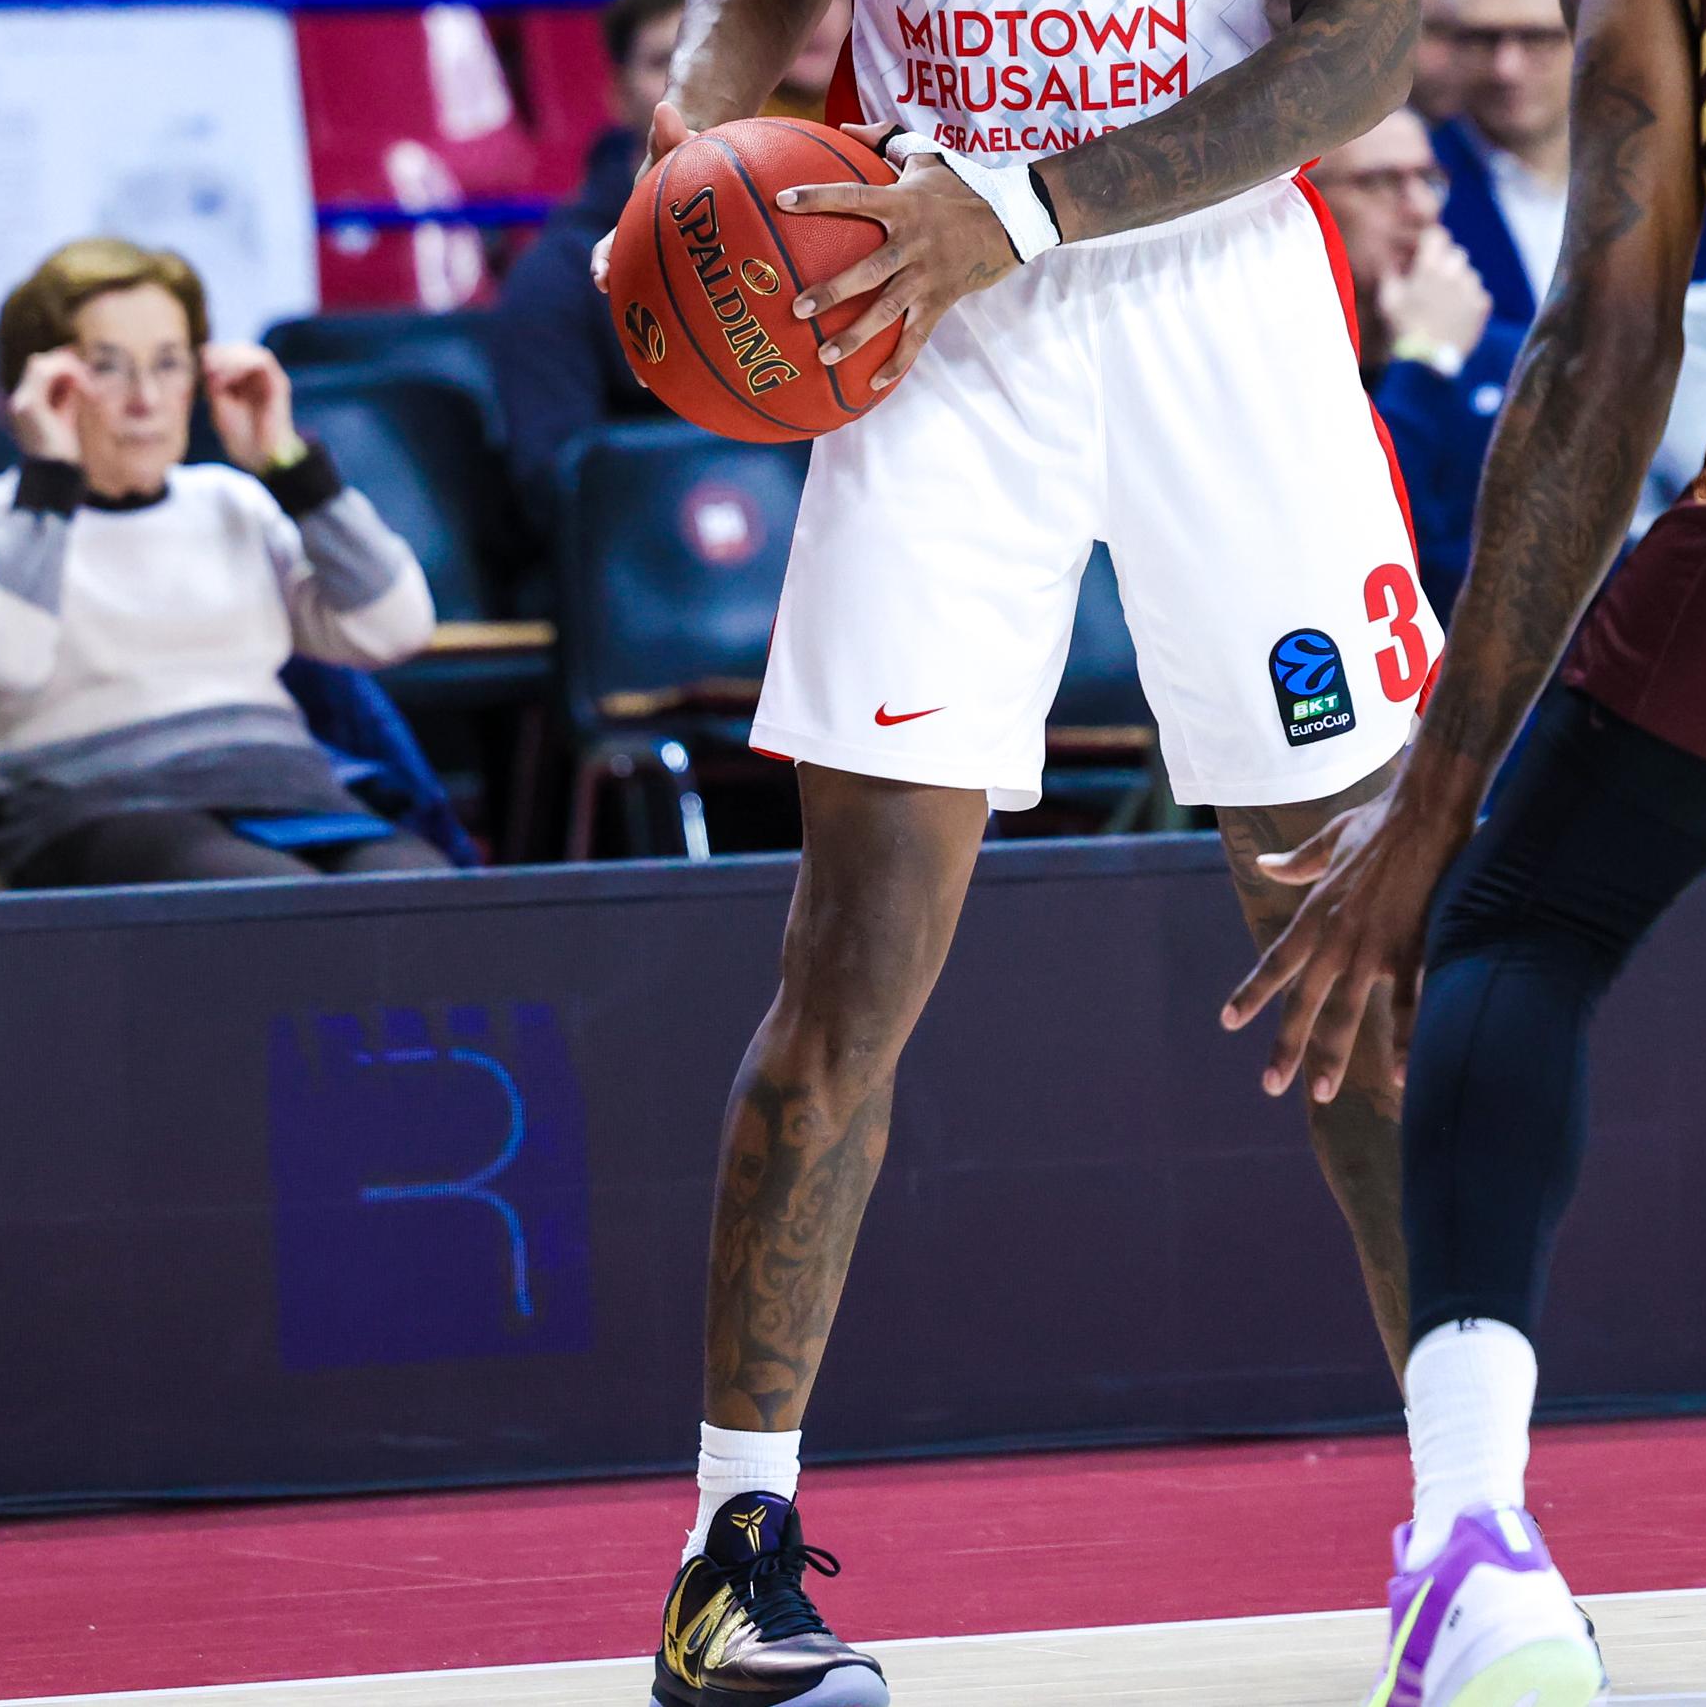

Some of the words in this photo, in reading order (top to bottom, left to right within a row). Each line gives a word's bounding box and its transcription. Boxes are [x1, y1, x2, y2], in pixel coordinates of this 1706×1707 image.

[896, 0, 1187, 57] MIDTOWN
[896, 52, 1189, 112] JERUSALEM
[934, 123, 1129, 153] ISRAELCANA
[669, 186, 800, 396] SPALDING
[1363, 562, 1429, 703] 3
[1290, 712, 1350, 737] EuroCup
[1293, 693, 1339, 720] BKT
